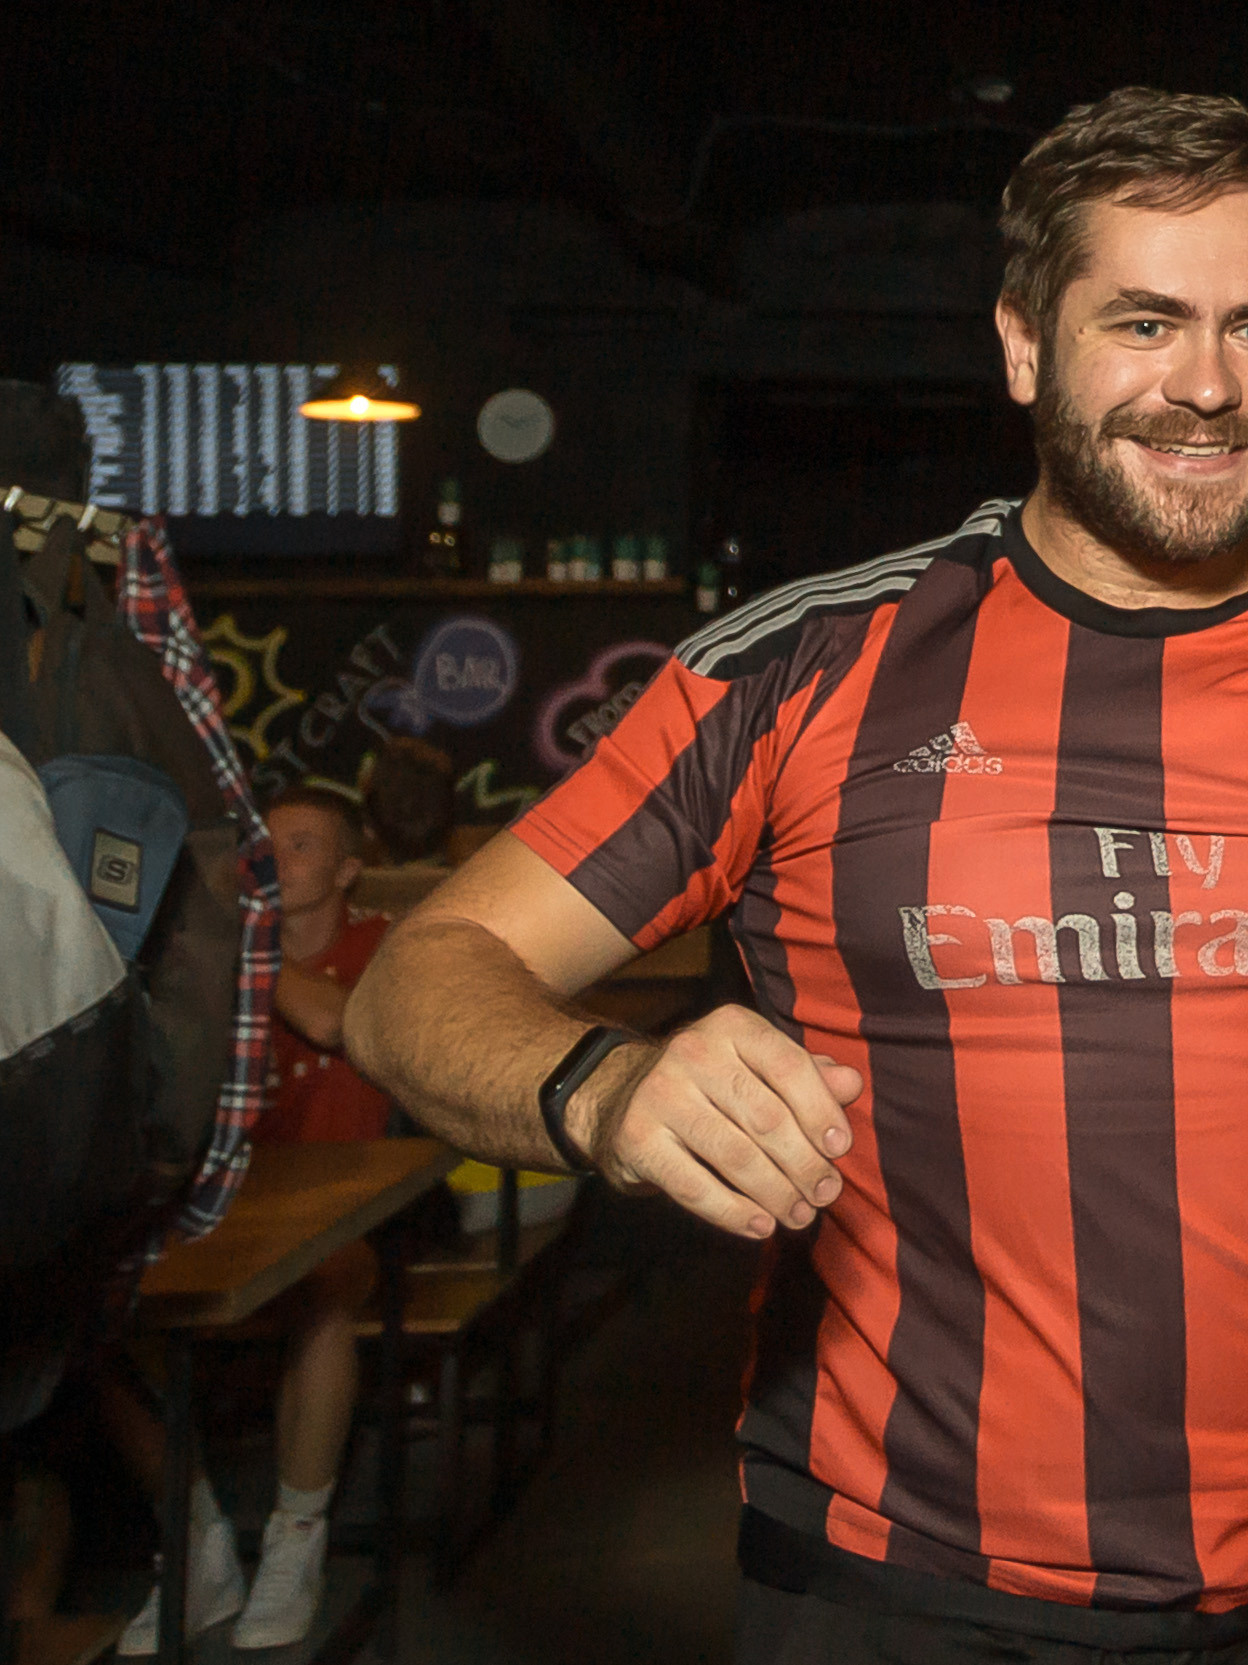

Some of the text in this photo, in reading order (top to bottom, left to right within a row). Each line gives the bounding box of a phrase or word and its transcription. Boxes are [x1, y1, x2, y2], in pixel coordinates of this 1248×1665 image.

[434, 653, 507, 692] BAR
[893, 752, 1003, 775] adidas
[1094, 826, 1226, 889] Fly
